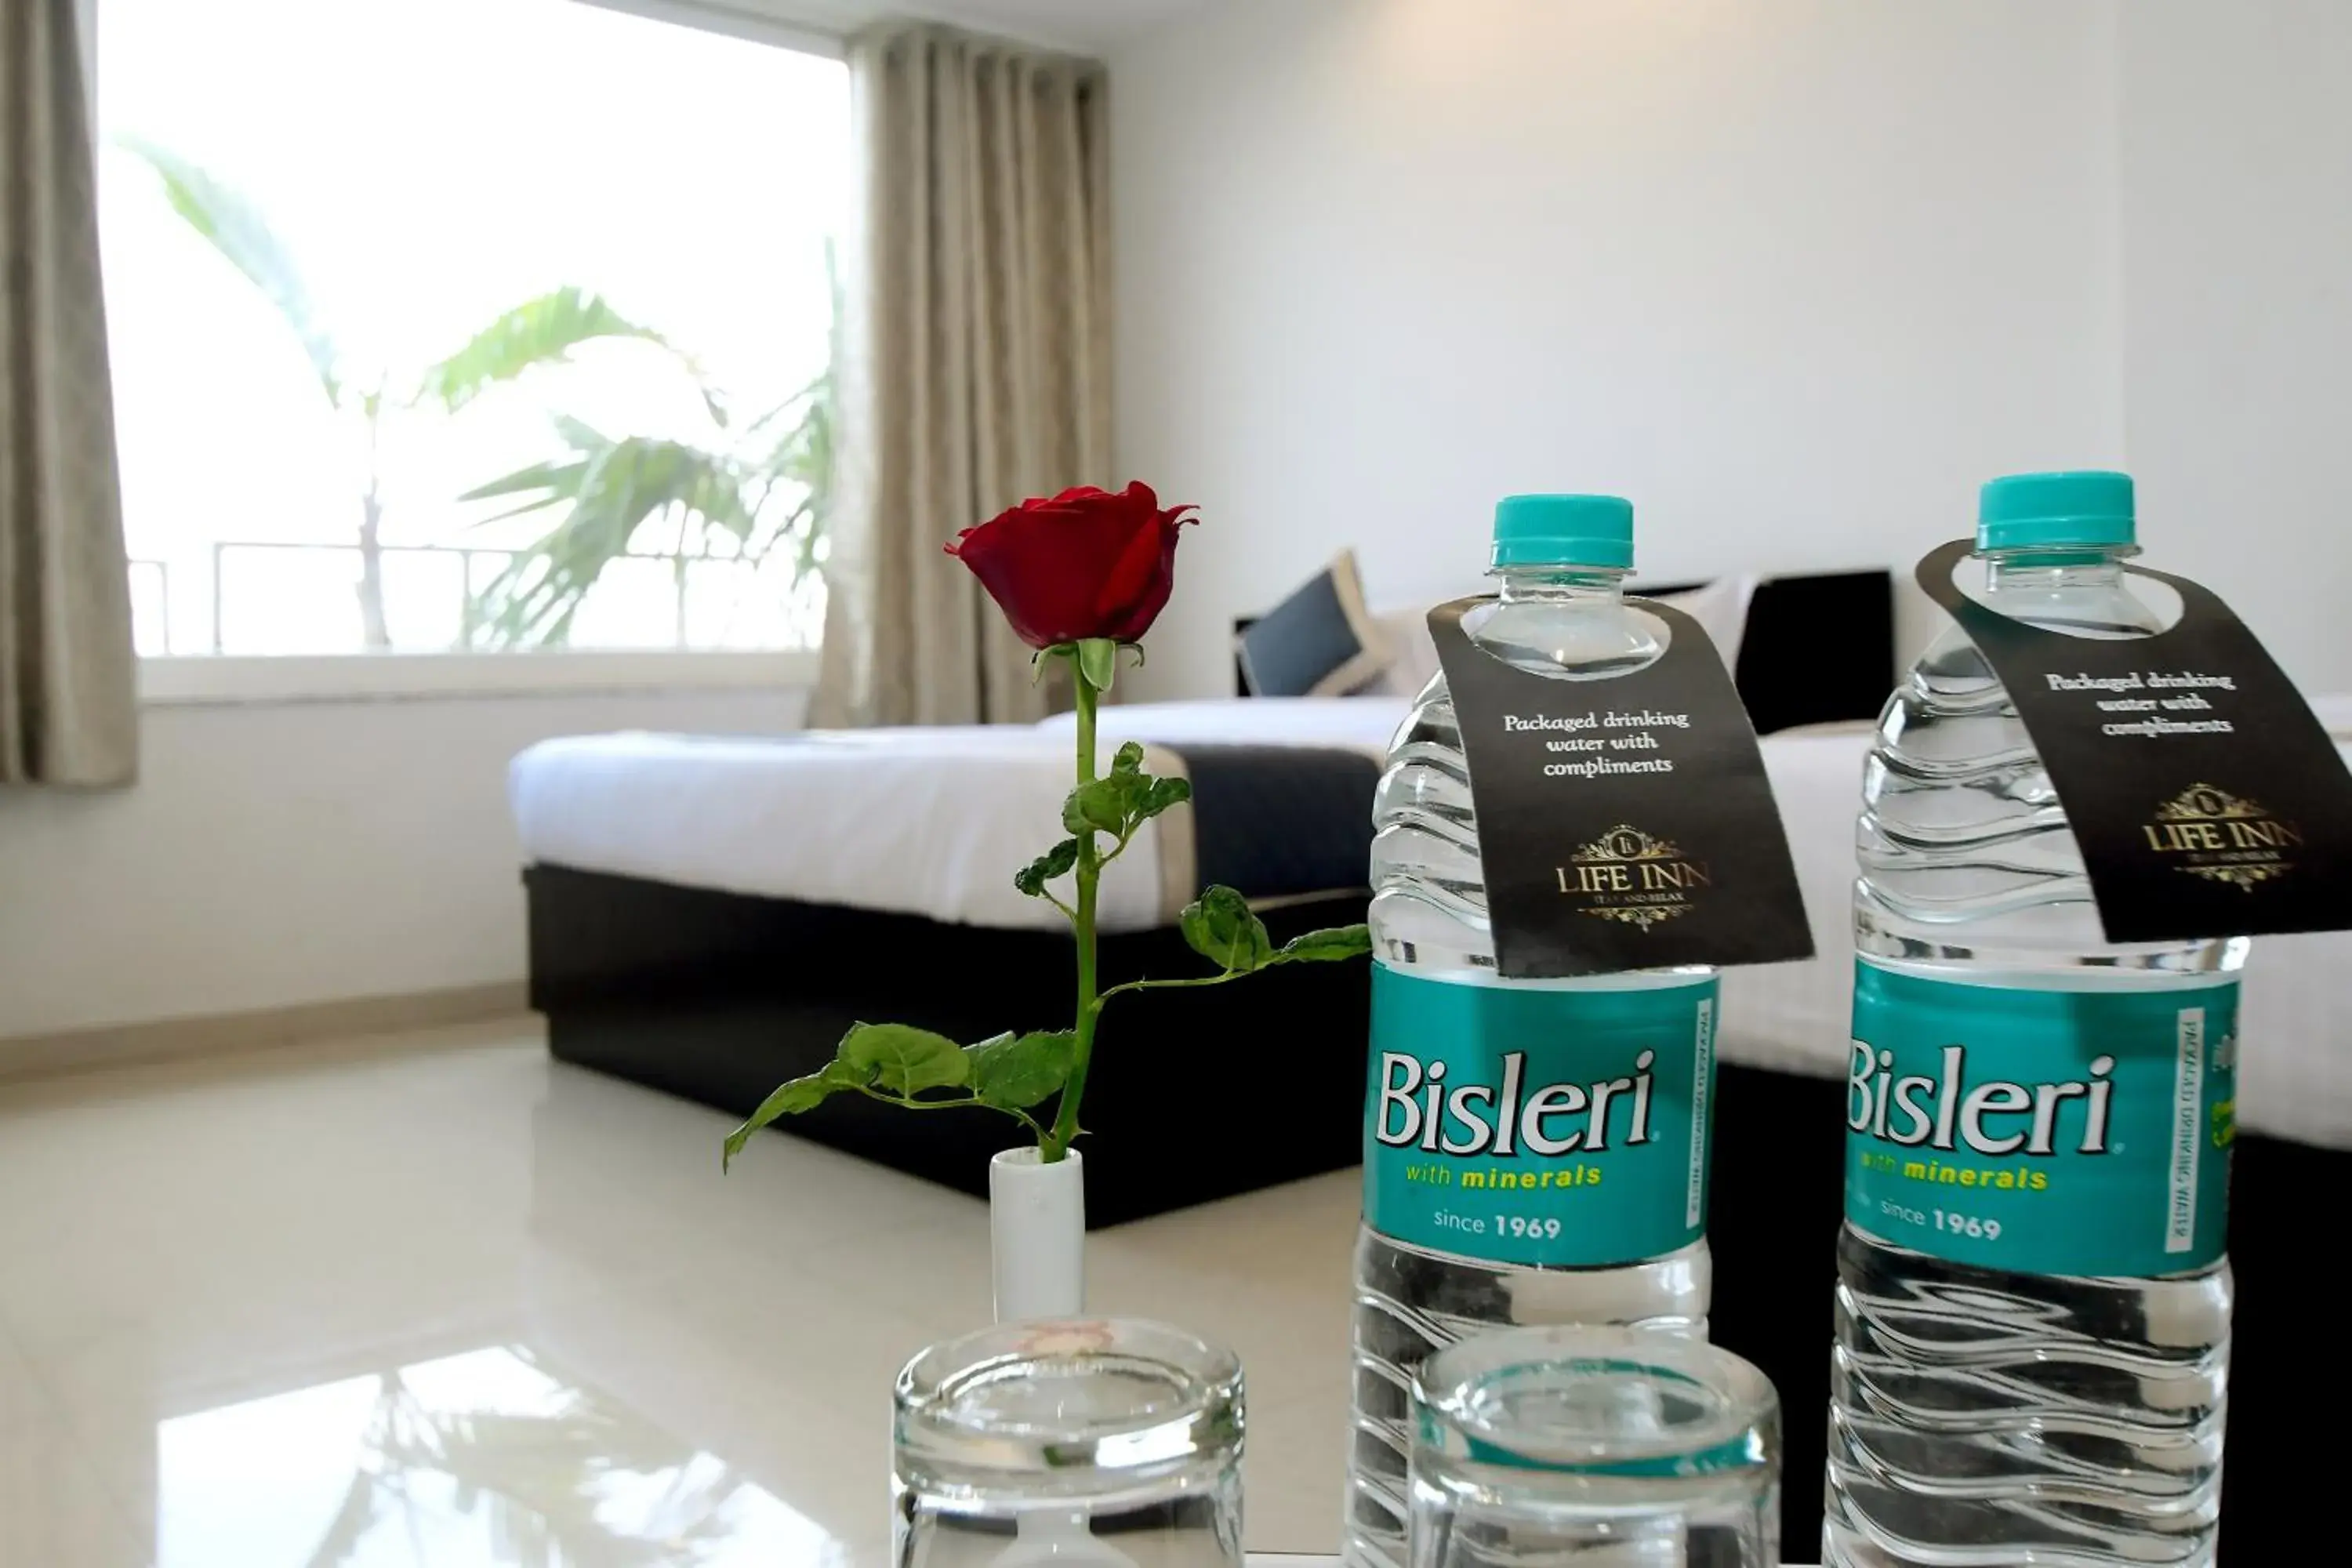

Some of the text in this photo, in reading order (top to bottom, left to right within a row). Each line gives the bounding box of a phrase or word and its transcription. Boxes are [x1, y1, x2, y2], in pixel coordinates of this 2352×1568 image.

[2044, 671, 2236, 692] Packaged drinking
[2096, 694, 2213, 713] water with
[1504, 710, 1691, 733] Packaged drinking
[2101, 717, 2235, 738] compliments
[1546, 732, 1659, 753] water with
[1544, 757, 1673, 779] compliments
[2141, 821, 2303, 851] LIFE INN
[1555, 861, 1712, 893] LIFE INN
[1374, 1048, 1656, 1158] Bisleri
[1846, 1036, 2118, 1156] Bisleri
[1406, 1163, 1602, 1189] with minerals
[1904, 1160, 2049, 1190] minerals
[1434, 1209, 1562, 1240] since 1969
[1881, 1198, 2002, 1241] since 1969
